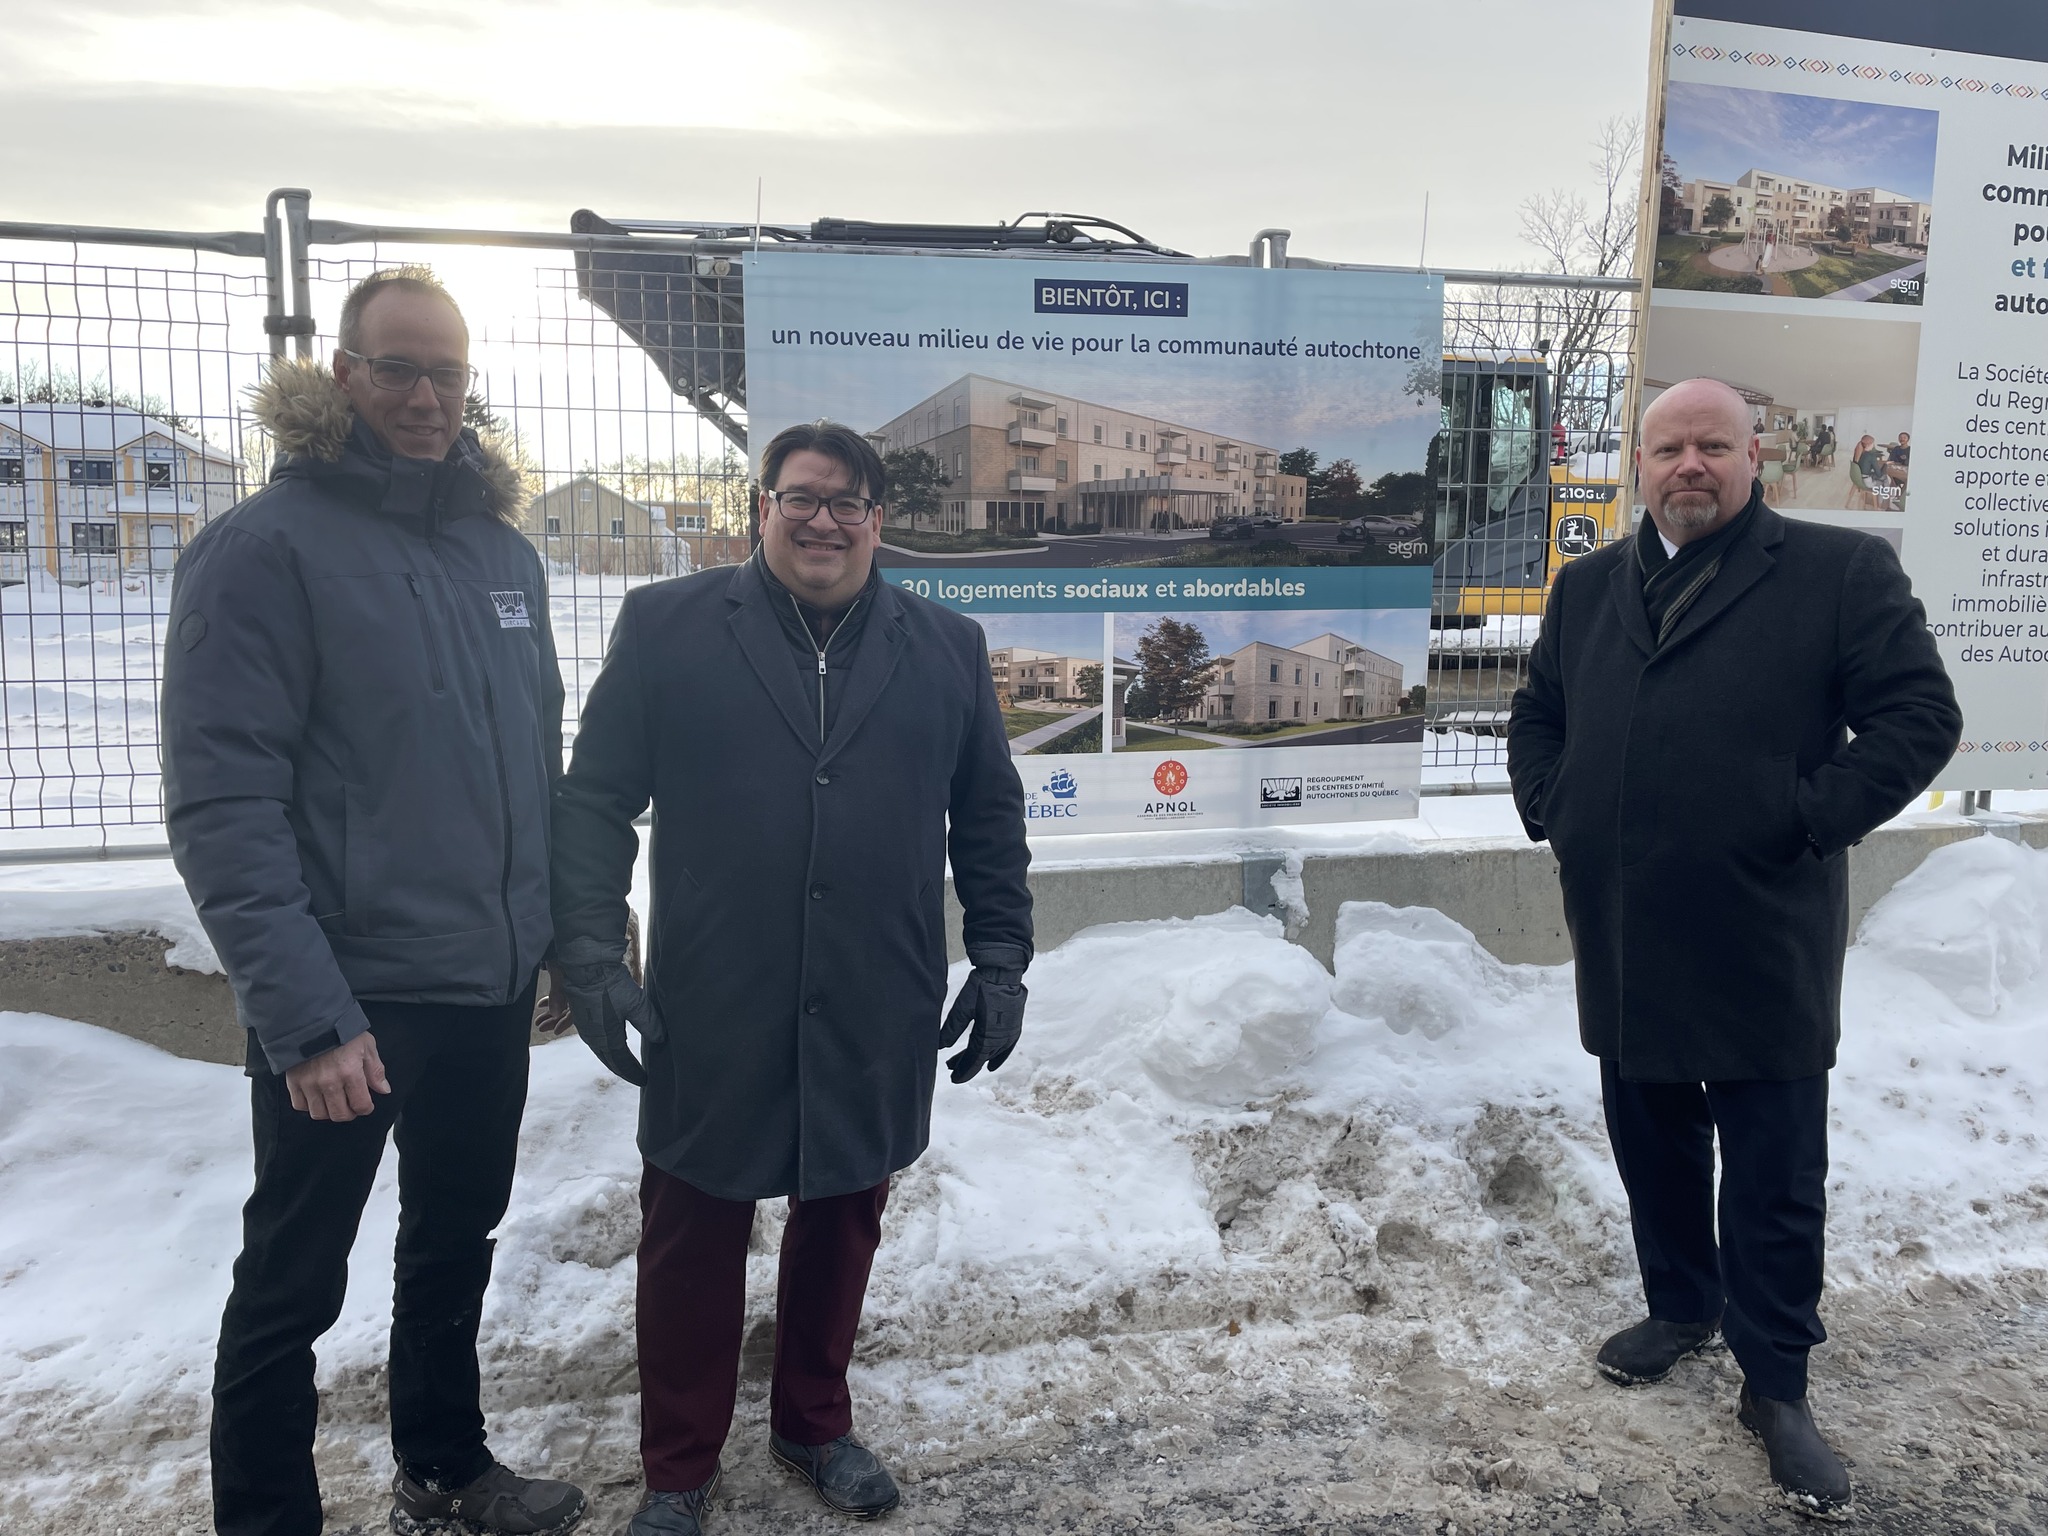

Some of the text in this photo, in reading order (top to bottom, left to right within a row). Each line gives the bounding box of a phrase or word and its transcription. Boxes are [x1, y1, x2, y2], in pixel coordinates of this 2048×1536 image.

[2014, 223, 2048, 246] po
[2011, 257, 2036, 278] et
[1890, 278, 1919, 293] stgm
[1042, 284, 1137, 310] BIENTÔT,
[1144, 290, 1169, 308] ICI
[1995, 293, 2048, 314] auto
[771, 328, 1420, 359] un nouveau milieu de vie pour la communauté autochtone
[1958, 362, 1979, 380] La
[1976, 389, 2001, 407] du
[1966, 414, 2000, 433] des
[1955, 470, 2048, 489] apporte e
[1560, 488, 1594, 499] 210G
[1872, 485, 1901, 499] stgm
[1954, 518, 2040, 537] solutions
[1388, 541, 1428, 558] stgm
[1982, 544, 2048, 562] et dura
[938, 579, 1057, 603] logements
[1063, 578, 1148, 598] sociaux
[1155, 581, 1177, 598] et
[1183, 578, 1305, 597] abordables
[1952, 594, 2047, 612] immobiliè
[1961, 645, 1994, 662] des
[1307, 775, 1364, 783] REGROUPEMENT
[1355, 781, 1384, 789] D'AMITIÉ
[1372, 789, 1399, 797] QUÉBEC
[1024, 802, 1078, 818] ÉBEC
[1144, 801, 1196, 813] APNQL
